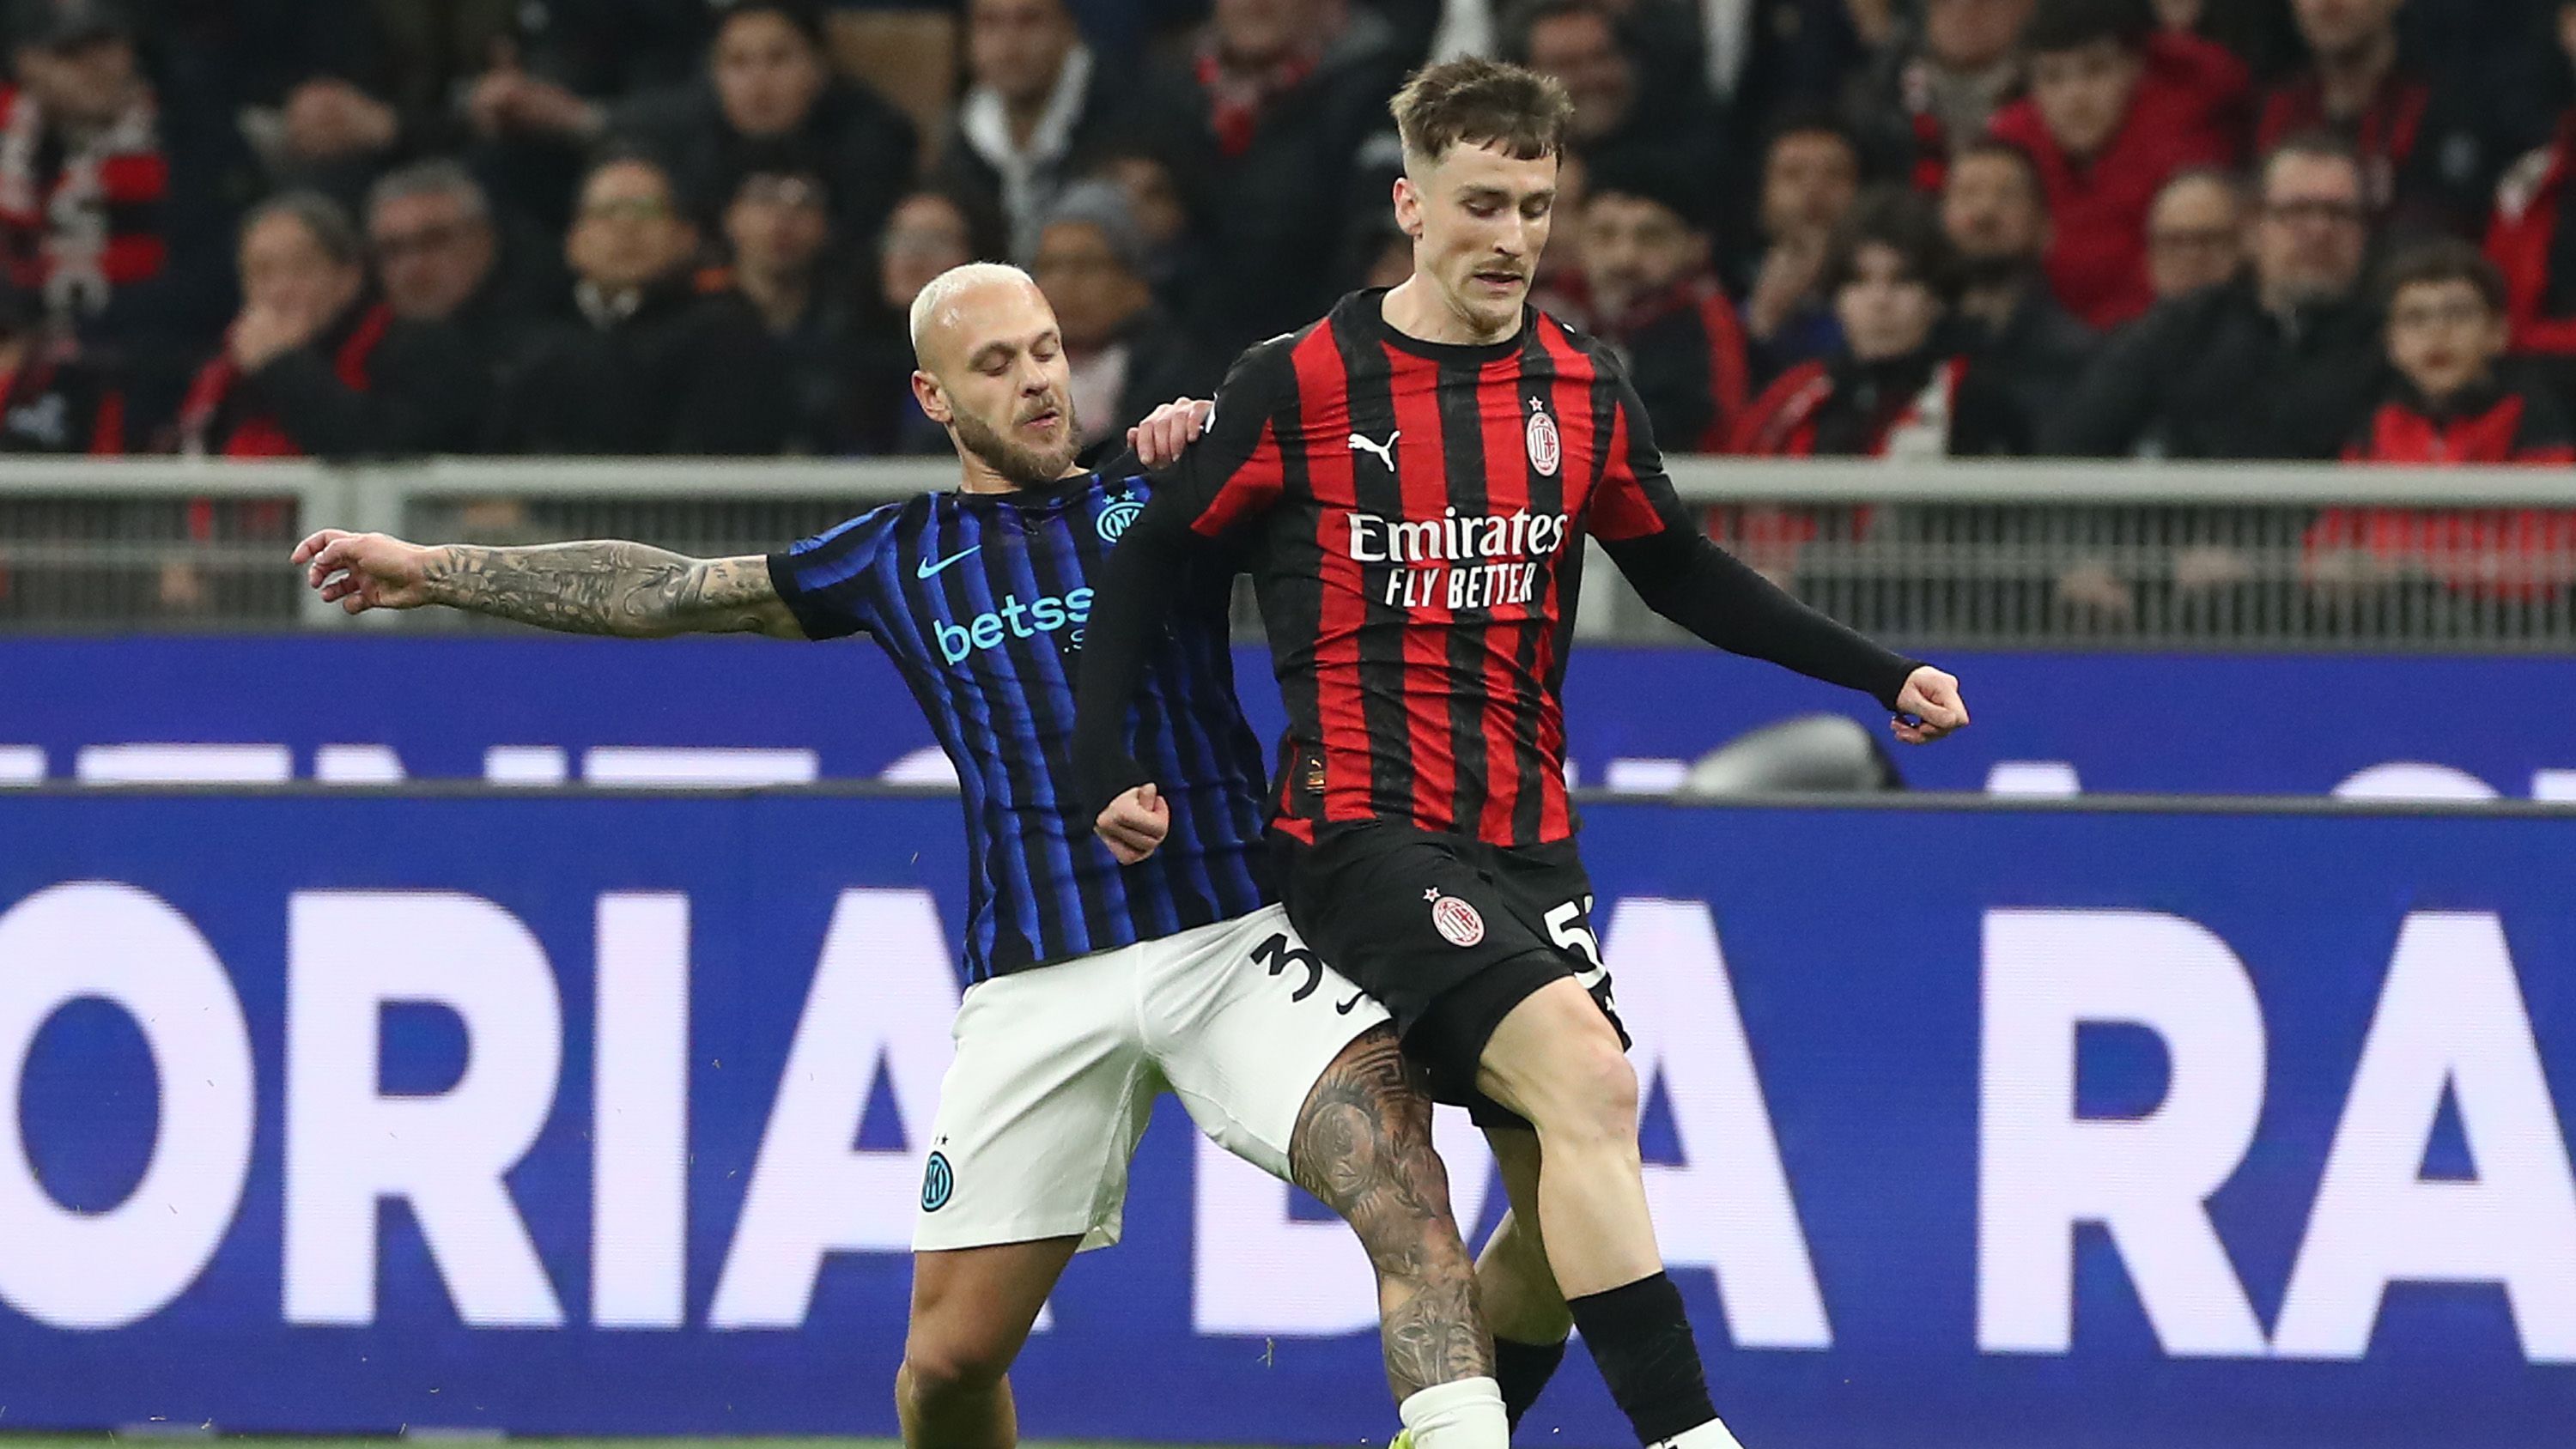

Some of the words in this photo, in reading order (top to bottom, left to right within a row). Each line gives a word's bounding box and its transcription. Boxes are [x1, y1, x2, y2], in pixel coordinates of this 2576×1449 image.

[1346, 506, 1568, 561] Emirates
[1384, 567, 1440, 608] FLY
[1447, 562, 1537, 609] BETTER
[933, 587, 1094, 665] betss
[1544, 894, 1607, 989] 5
[0, 879, 1054, 1330] ORIA
[1975, 907, 2576, 1363] RA
